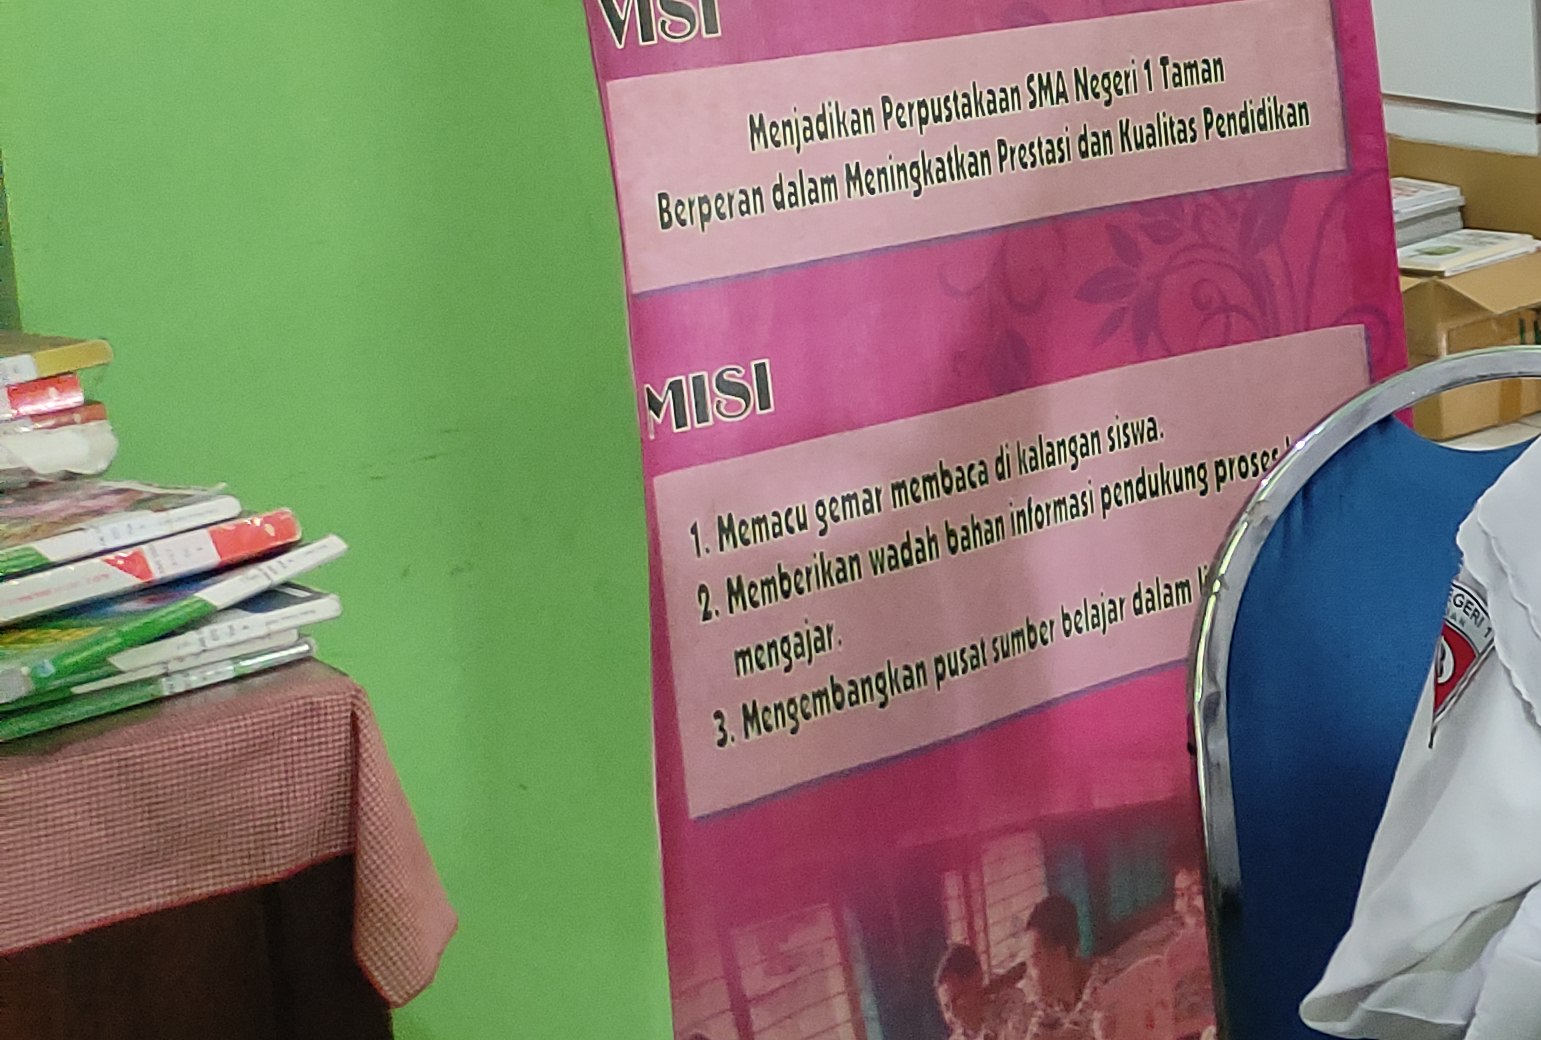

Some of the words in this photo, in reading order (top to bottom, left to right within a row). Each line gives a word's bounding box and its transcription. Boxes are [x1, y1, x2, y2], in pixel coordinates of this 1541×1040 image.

[749, 108, 875, 153] Menjadikan
[882, 86, 1021, 133] Perpustakaan
[1027, 70, 1069, 110] SMA
[1073, 59, 1140, 106] Negeri
[1143, 59, 1154, 93] 1
[1160, 52, 1225, 90] Taman
[658, 173, 766, 233] Berperan
[771, 163, 839, 211] dalam
[844, 142, 992, 203] Meningkatkan
[997, 126, 1072, 173] Prestasi
[1077, 128, 1113, 161] dan
[1118, 113, 1197, 155] Kualitas
[1203, 96, 1310, 141] Pendidikan
[645, 359, 774, 439] MISI
[690, 524, 711, 558] 1.
[716, 505, 808, 554] Memacu
[815, 489, 883, 537] gemar
[891, 459, 990, 510] membaca
[994, 445, 1011, 482] di
[1016, 431, 1102, 477] kalangan
[1106, 413, 1165, 454] siswa.
[698, 583, 719, 623] 2.
[726, 556, 863, 615] Memberikan
[870, 533, 941, 575] wadah
[945, 513, 1006, 557] bahan
[1010, 488, 1095, 540] informasi
[1100, 461, 1209, 520] pendukung
[1214, 445, 1280, 491] proses
[713, 710, 735, 748] 3.
[741, 660, 929, 737] Mengembangkan
[933, 639, 989, 690] pusat
[991, 619, 1057, 665] sumber
[1060, 598, 1127, 649] belajar
[1131, 573, 1193, 618] dalam
[733, 620, 843, 679] mengajar.
[1483, 627, 1493, 639] 1
